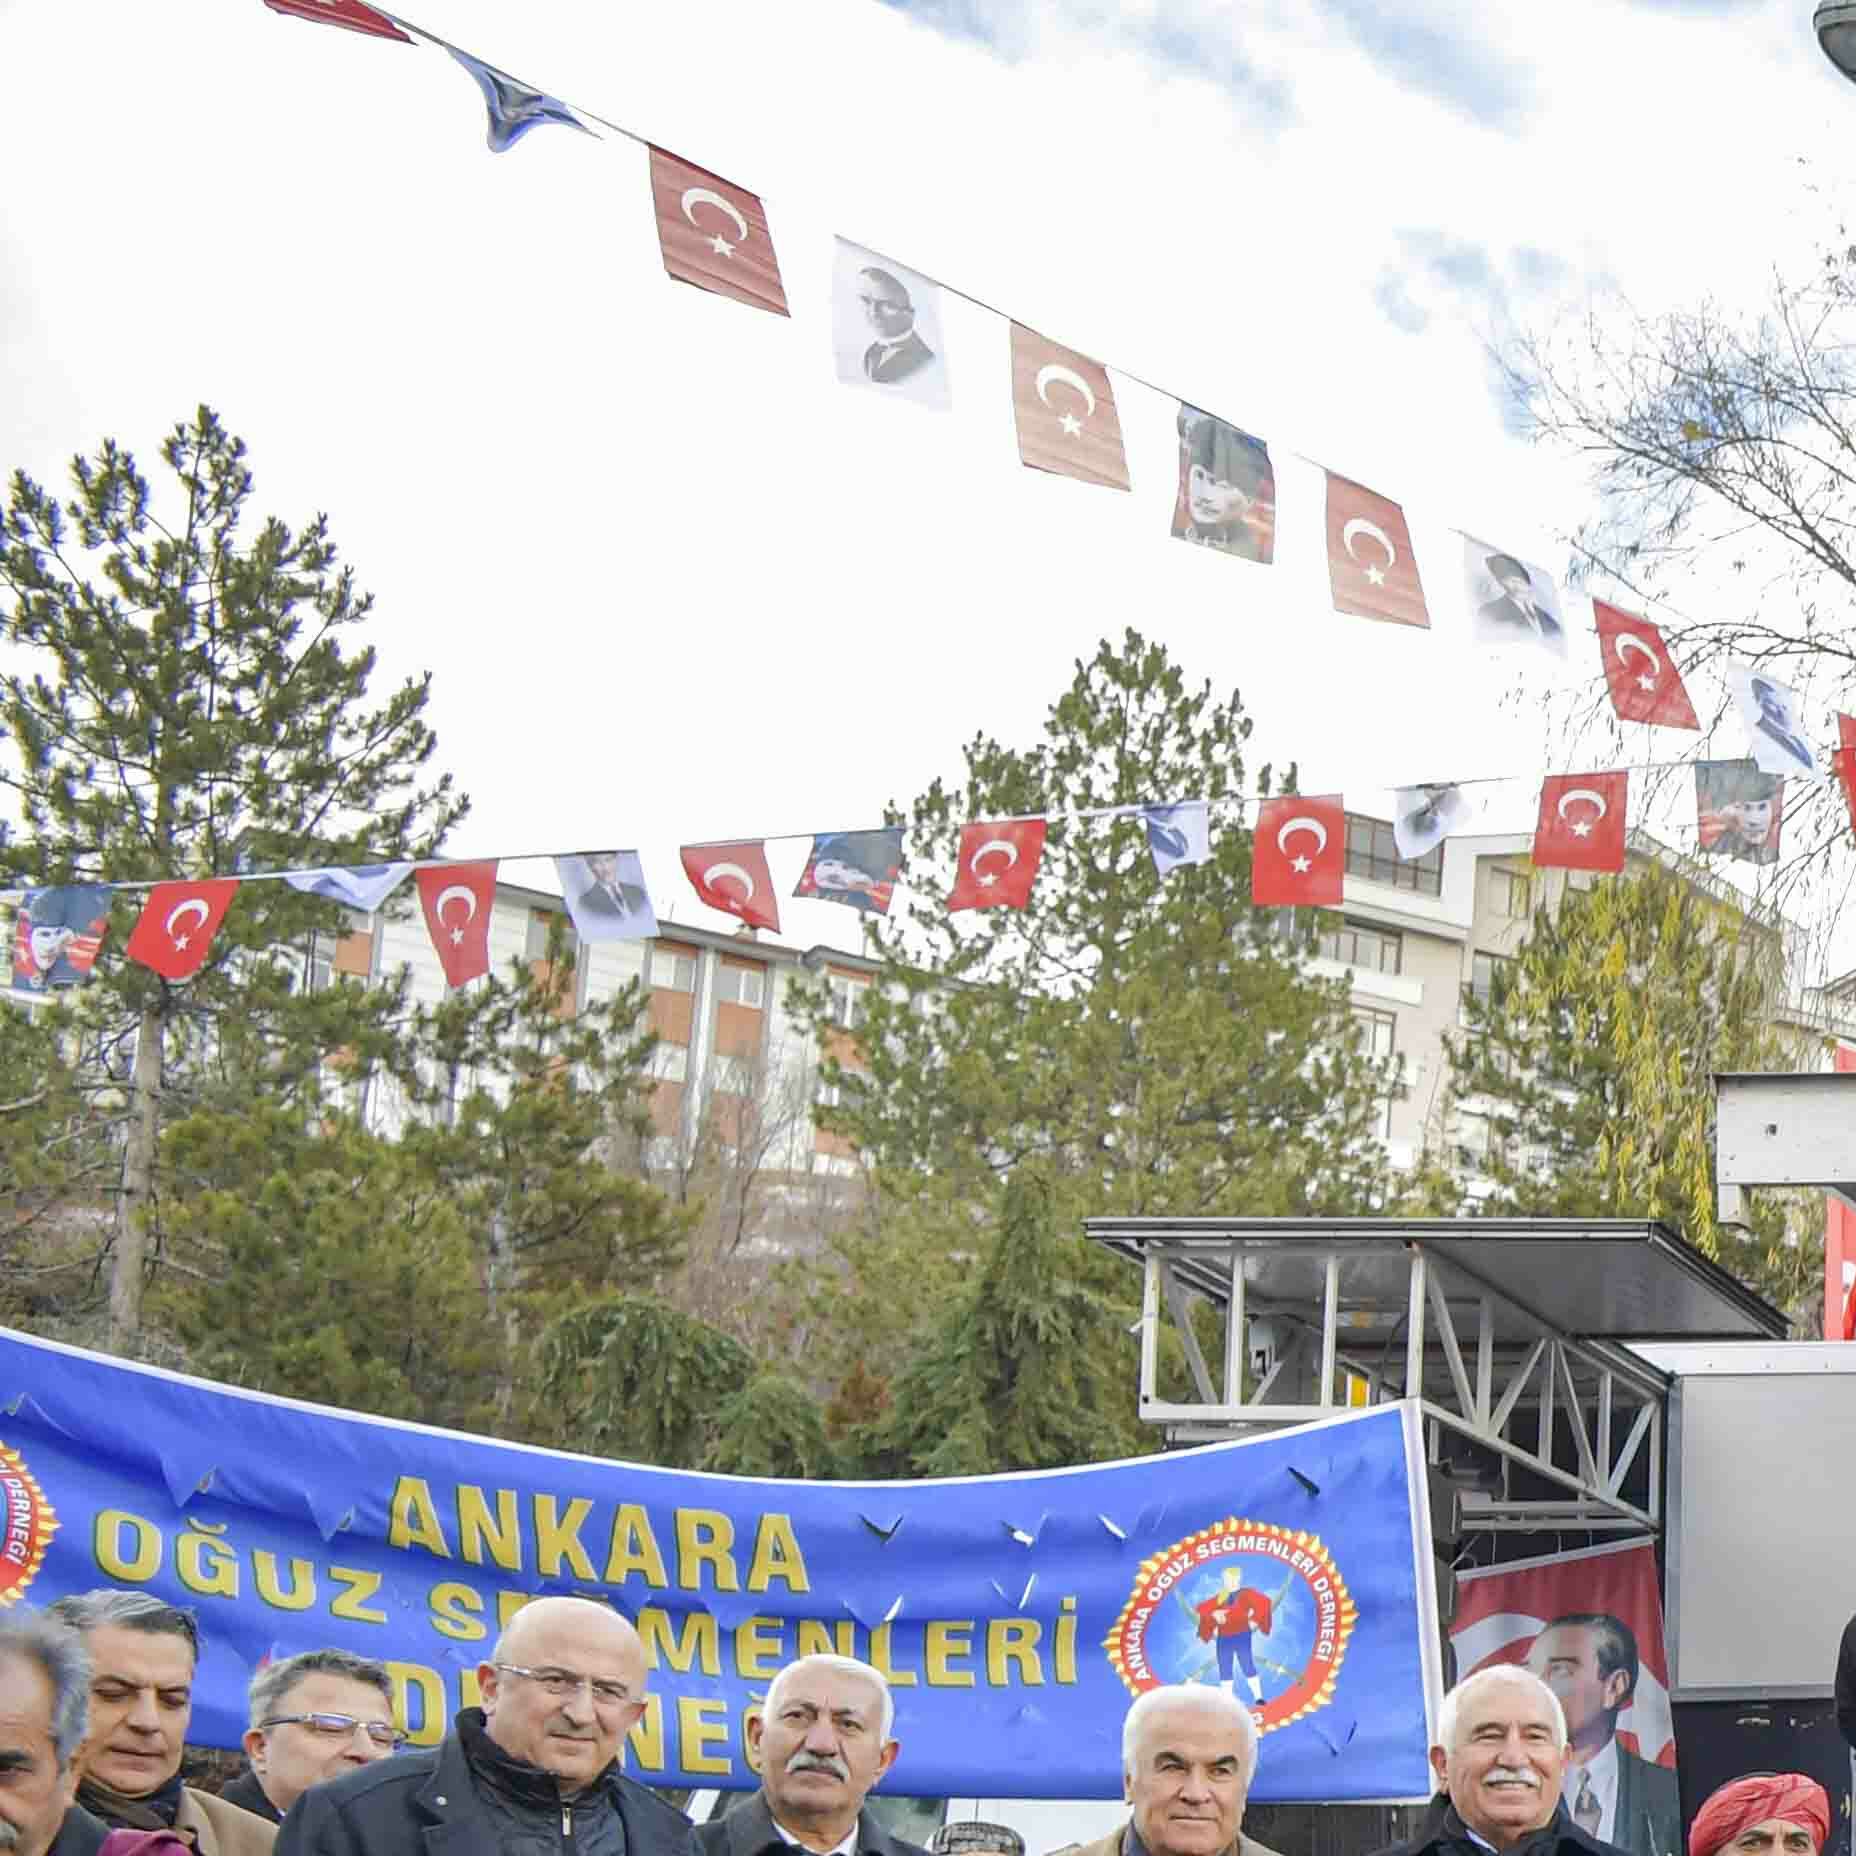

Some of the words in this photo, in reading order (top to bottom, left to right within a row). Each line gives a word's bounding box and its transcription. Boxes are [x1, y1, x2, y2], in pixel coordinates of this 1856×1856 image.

[389, 1475, 810, 1593] ANKARA
[95, 1509, 388, 1624] OĞUZ
[428, 1582, 1078, 1686] SMENLERİ
[1124, 1606, 1151, 1681] ANKARA
